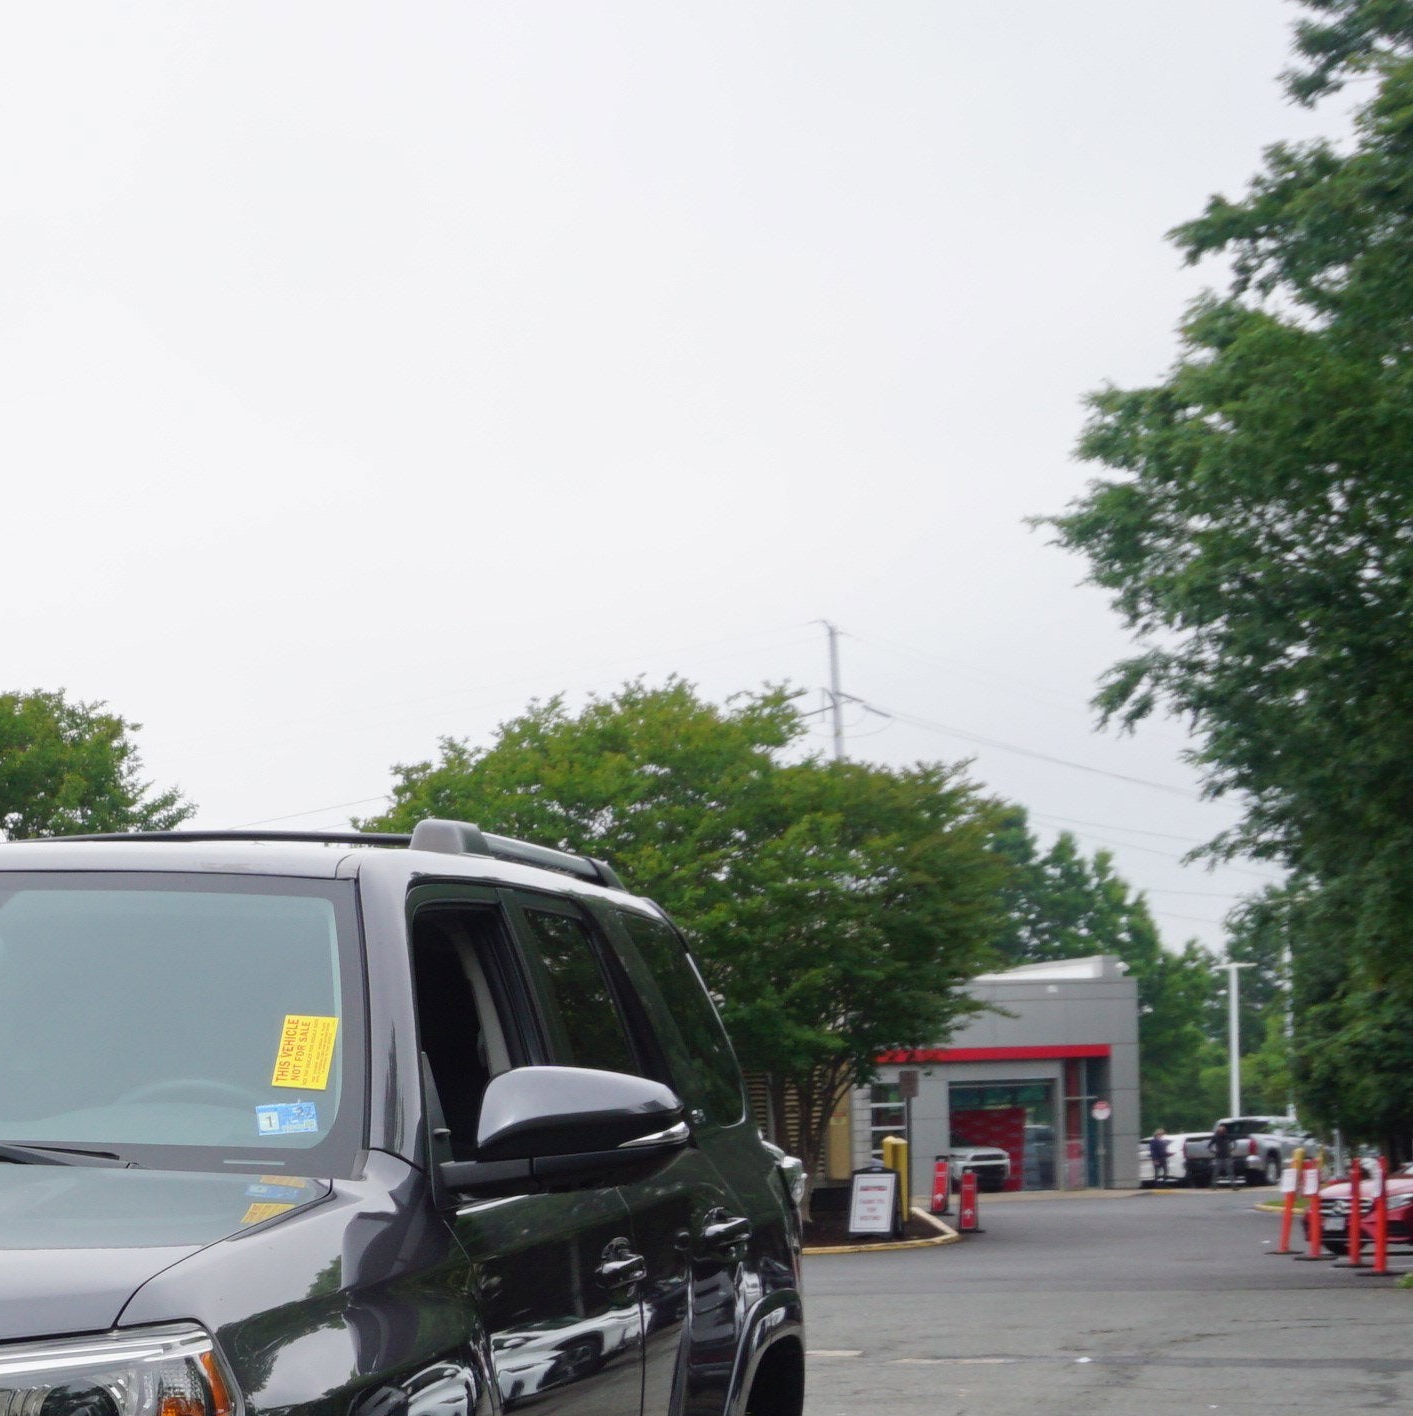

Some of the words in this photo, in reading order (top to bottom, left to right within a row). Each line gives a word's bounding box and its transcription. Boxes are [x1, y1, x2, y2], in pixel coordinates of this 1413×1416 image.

[281, 1018, 298, 1058] VEHICLE
[300, 1021, 311, 1043] SALE
[294, 1044, 306, 1062] FOR
[276, 1060, 290, 1082] THIS
[291, 1064, 302, 1081] NOT
